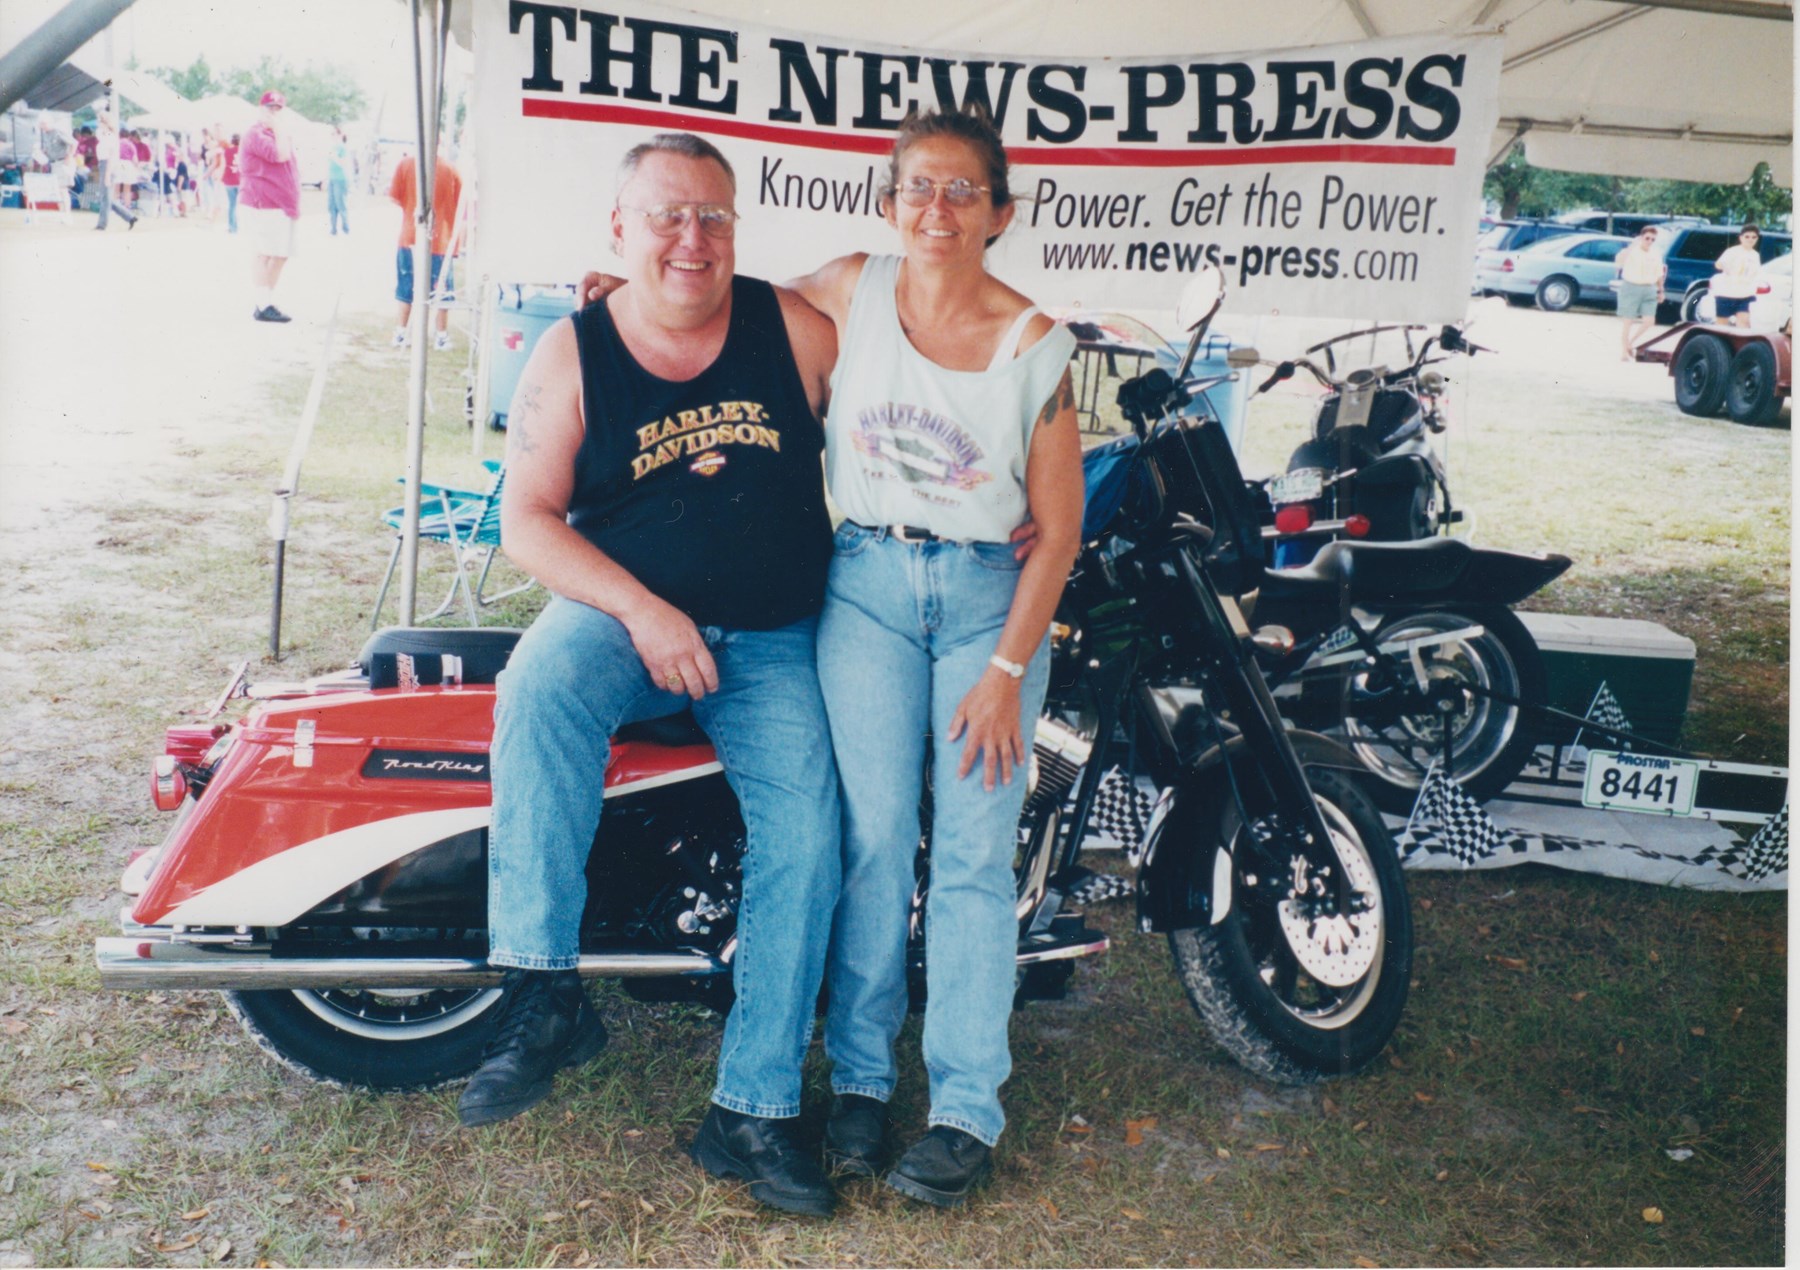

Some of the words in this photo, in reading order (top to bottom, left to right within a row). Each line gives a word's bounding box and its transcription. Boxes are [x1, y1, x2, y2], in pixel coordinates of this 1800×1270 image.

[509, 1, 738, 115] THE
[768, 39, 1467, 145] NEWS-PRESS
[1031, 178, 1152, 228] Power.
[1170, 176, 1232, 227] Get
[1243, 172, 1301, 228] the
[1318, 175, 1446, 235] Power.
[1043, 240, 1419, 287] www.news-press.com
[636, 400, 770, 451] HARLEY-
[857, 401, 985, 467] HARLEY-DAVIDSON
[631, 423, 781, 481] DAVIDSON
[912, 487, 930, 500] THE
[1600, 767, 1678, 804] 8441
[1616, 752, 1671, 770] PROSTAR
